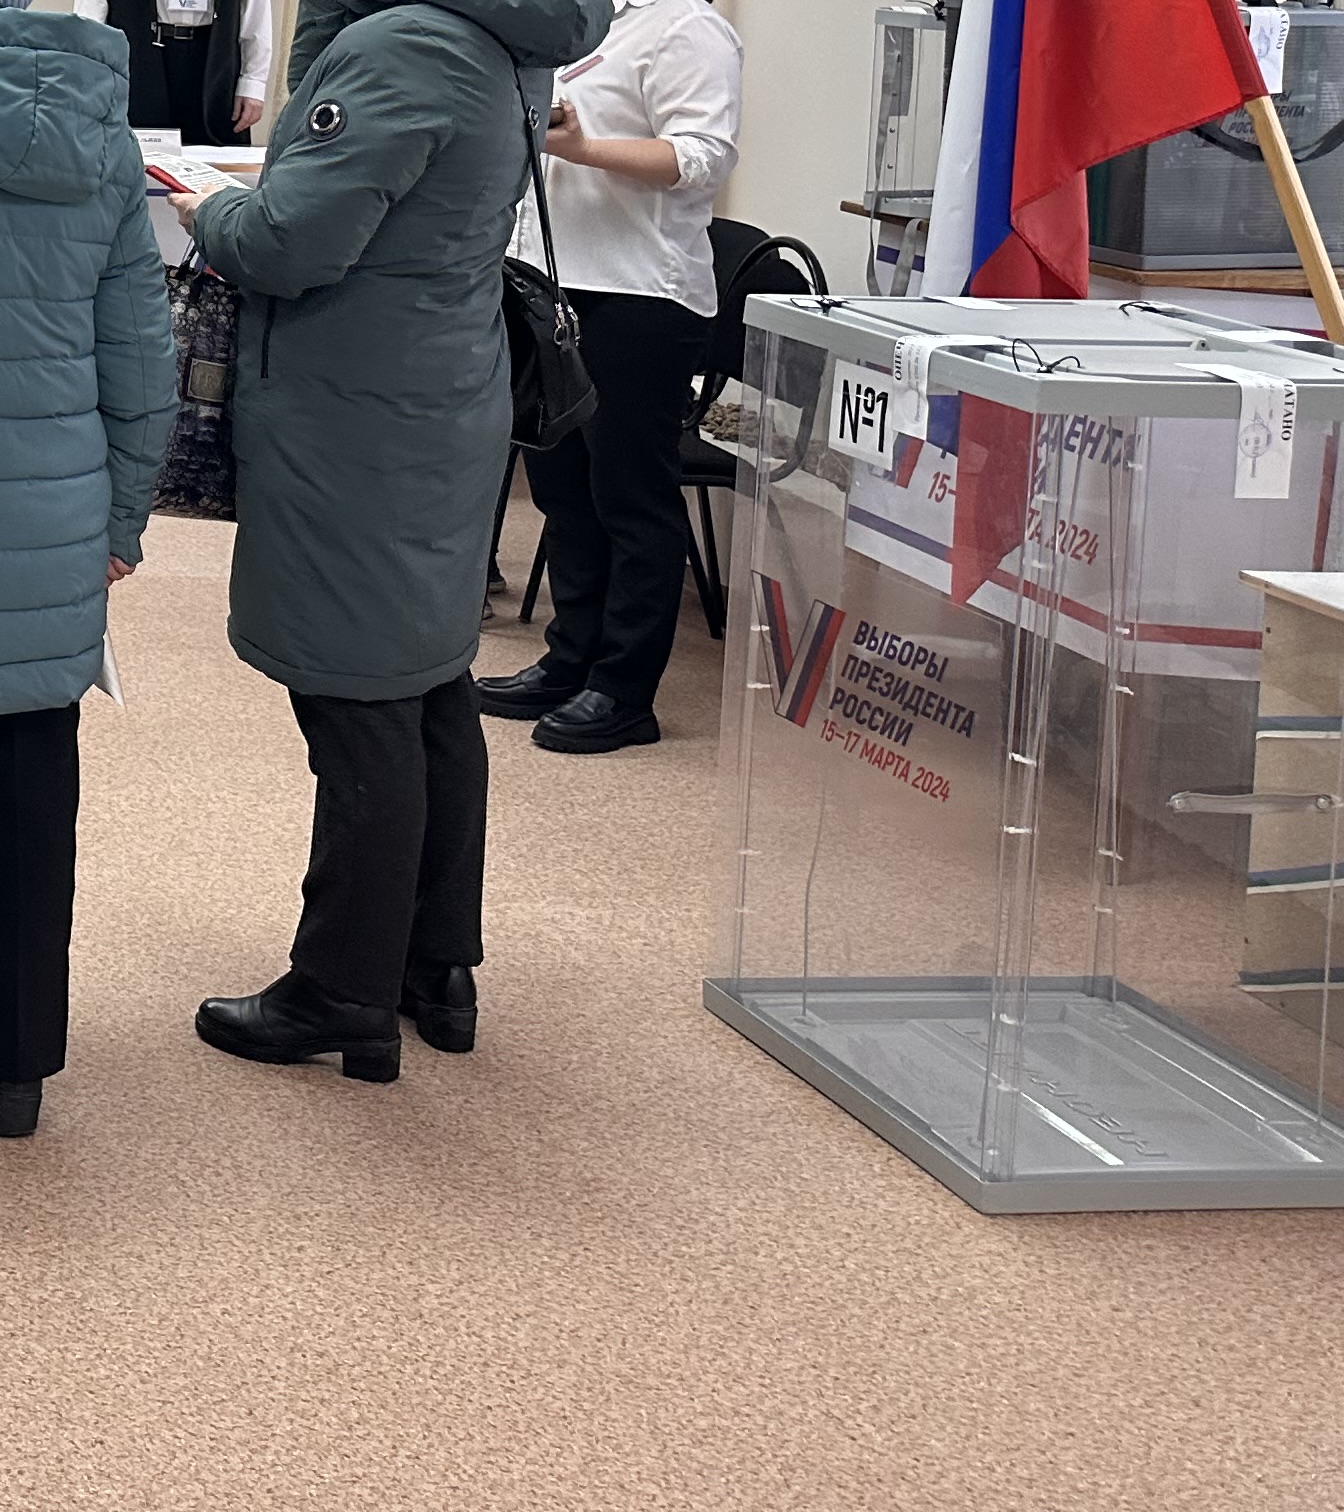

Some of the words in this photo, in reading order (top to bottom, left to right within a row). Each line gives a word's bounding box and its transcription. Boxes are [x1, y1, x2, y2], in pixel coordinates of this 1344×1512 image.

[838, 379, 888, 453] №1
[852, 620, 949, 683] ВЫБОРЫ
[828, 687, 914, 747] РОССИИ
[840, 654, 976, 738] ПРЕЗИДЕНТА
[859, 738, 912, 783] МАРТА
[912, 766, 951, 803] 2024
